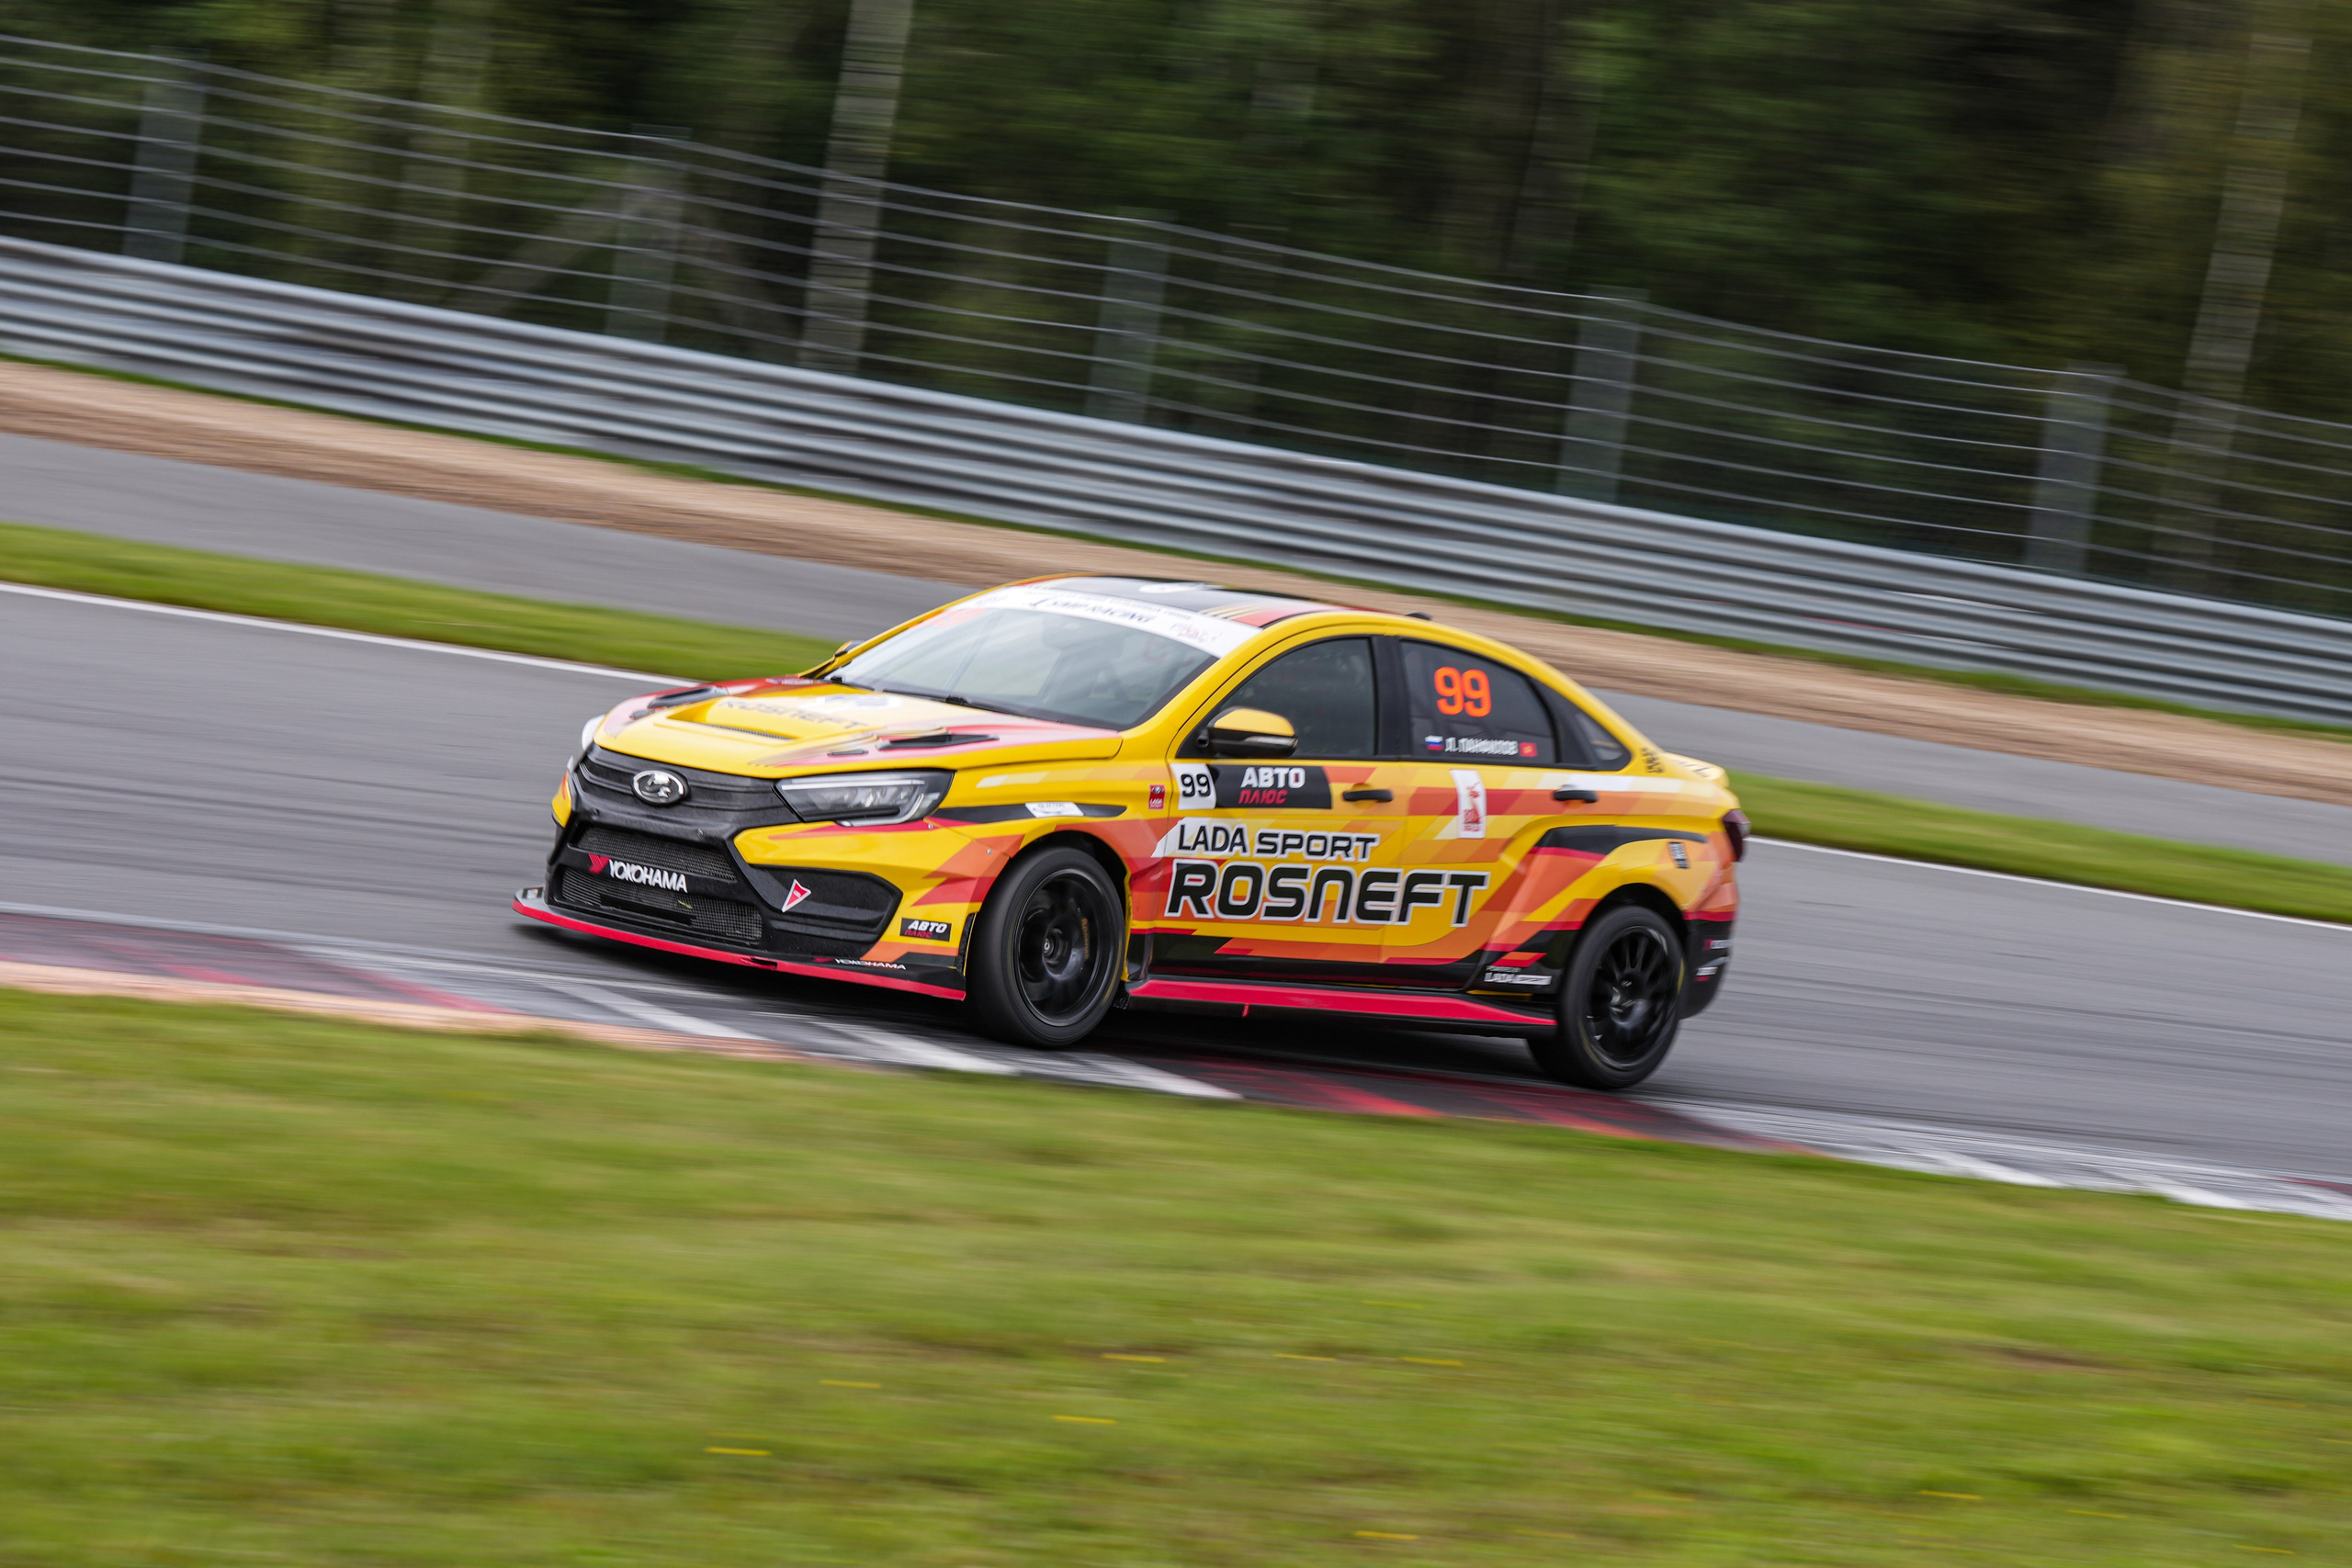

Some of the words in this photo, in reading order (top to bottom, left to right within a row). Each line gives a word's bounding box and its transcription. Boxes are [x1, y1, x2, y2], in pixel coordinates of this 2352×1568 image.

[1434, 666, 1491, 717] 99
[1181, 773, 1211, 797] 99
[1240, 766, 1306, 789] АВТО
[1238, 789, 1288, 805] ПЛЮС
[1177, 823, 1249, 855] LADA
[1255, 830, 1379, 862] SPORT
[608, 858, 688, 894] YOKOHAMA
[1164, 858, 1491, 928] ROSNEFT
[904, 930, 933, 939] ПЛЮС
[908, 919, 948, 934] АВТО
[834, 957, 907, 971] YOKOHAMA
